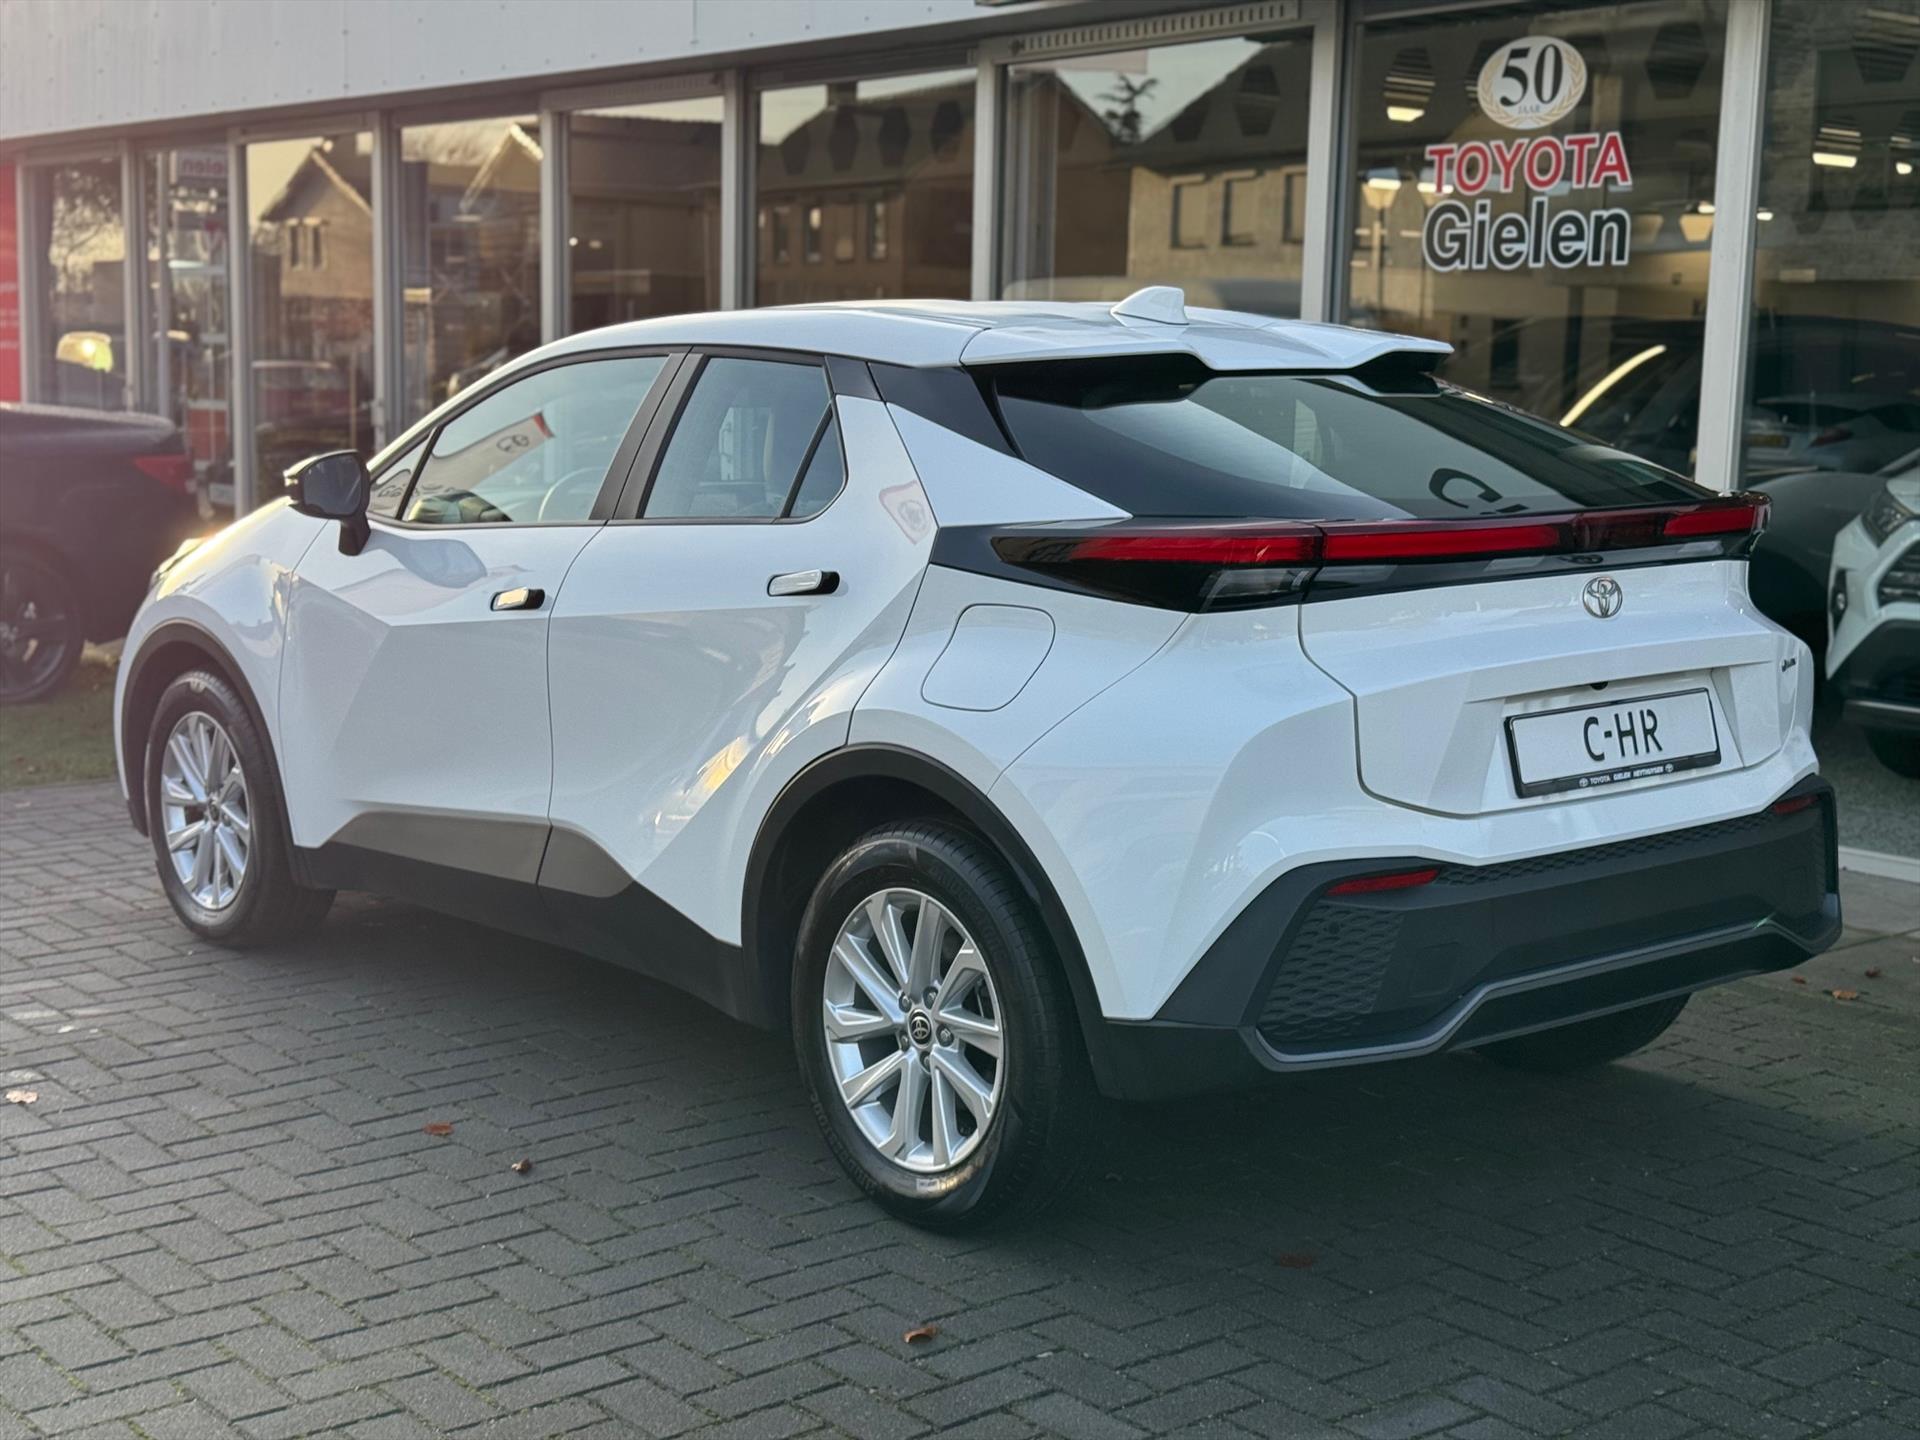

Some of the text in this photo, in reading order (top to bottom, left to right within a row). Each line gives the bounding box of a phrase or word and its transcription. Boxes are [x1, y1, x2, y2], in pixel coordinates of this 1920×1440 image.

[1500, 44, 1563, 107] 50
[1426, 132, 1632, 195] TOYOTA
[1423, 197, 1629, 271] Gielen
[1583, 709, 1663, 761] C-HR
[1590, 775, 1610, 785] TOYOTA
